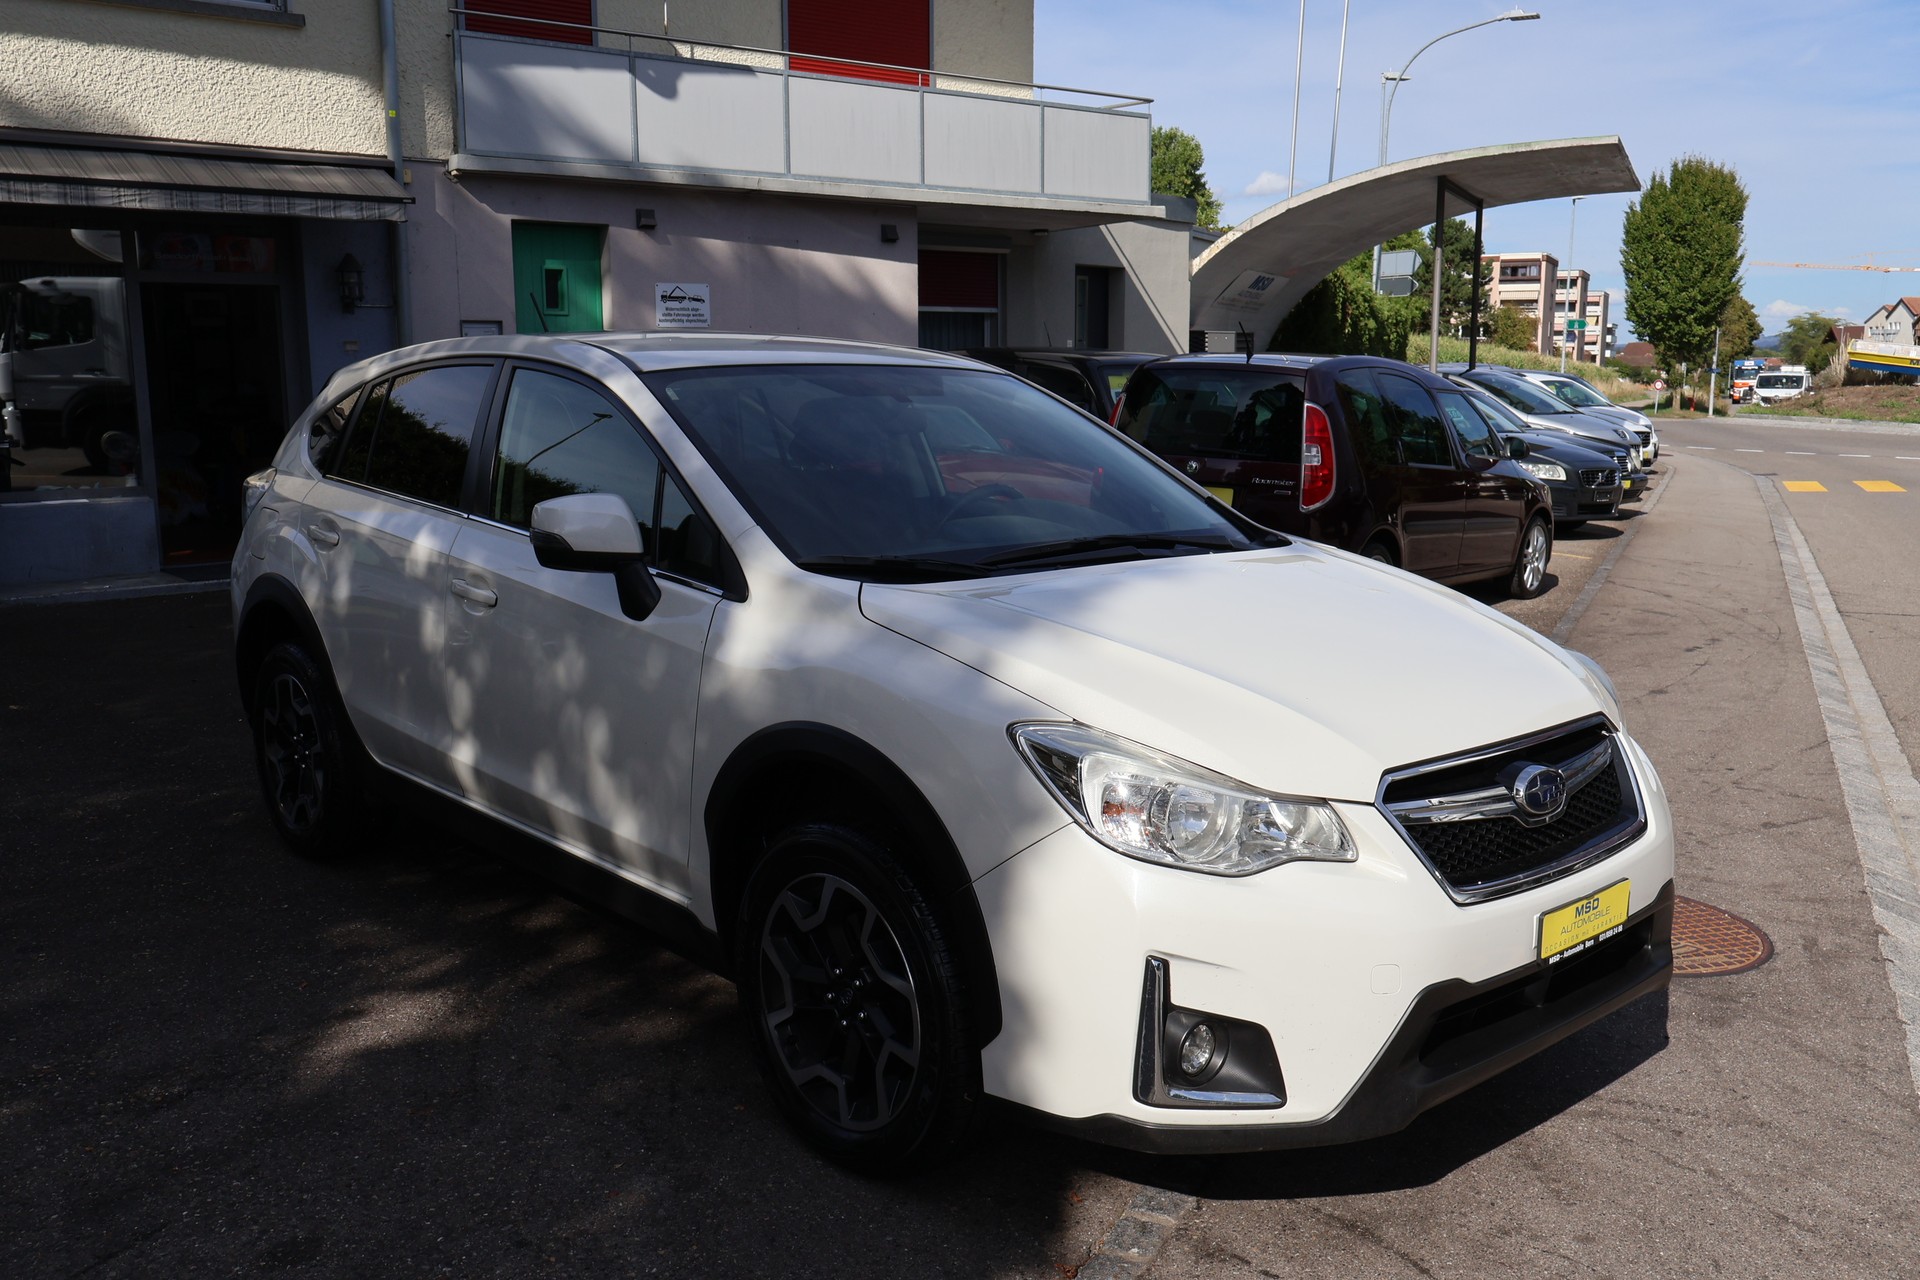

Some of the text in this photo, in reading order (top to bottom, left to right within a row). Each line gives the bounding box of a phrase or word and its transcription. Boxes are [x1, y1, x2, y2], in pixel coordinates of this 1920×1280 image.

[1248, 275, 1275, 291] MSD
[1251, 477, 1296, 486] Roomster
[1575, 898, 1600, 919] MSD
[1560, 906, 1611, 935] AUTOMOBILE
[1545, 934, 1579, 953] OCCASION
[1592, 912, 1623, 932] GARANTIE
